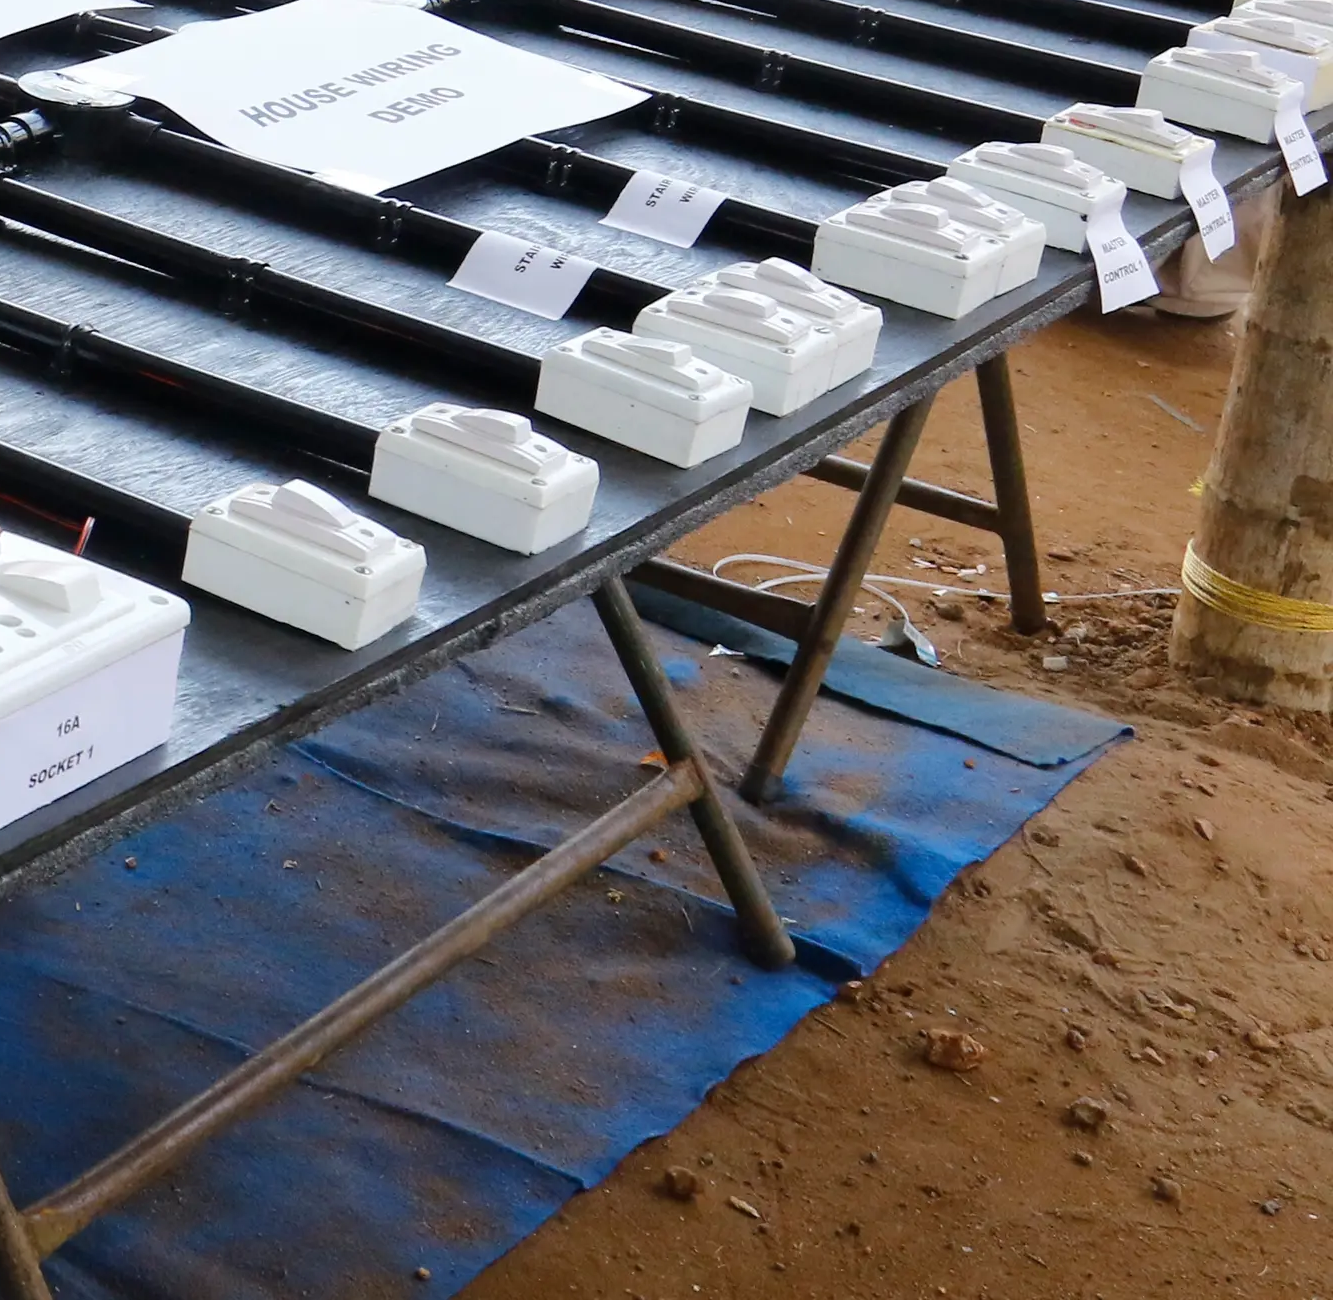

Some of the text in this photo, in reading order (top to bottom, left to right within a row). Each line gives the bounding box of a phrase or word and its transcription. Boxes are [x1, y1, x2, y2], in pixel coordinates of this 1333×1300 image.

[238, 43, 462, 128] HOUSE WIRING
[366, 87, 465, 124] DEMO
[1283, 129, 1305, 146] MASTER
[1289, 153, 1314, 172] CONTROL
[1196, 188, 1220, 209] MASTER
[1201, 217, 1226, 238] CONTROL
[1101, 237, 1128, 254] MASTER
[1104, 263, 1138, 284] CONTROL
[57, 715, 81, 738] 16A
[28, 745, 95, 790] SOCKET 1
